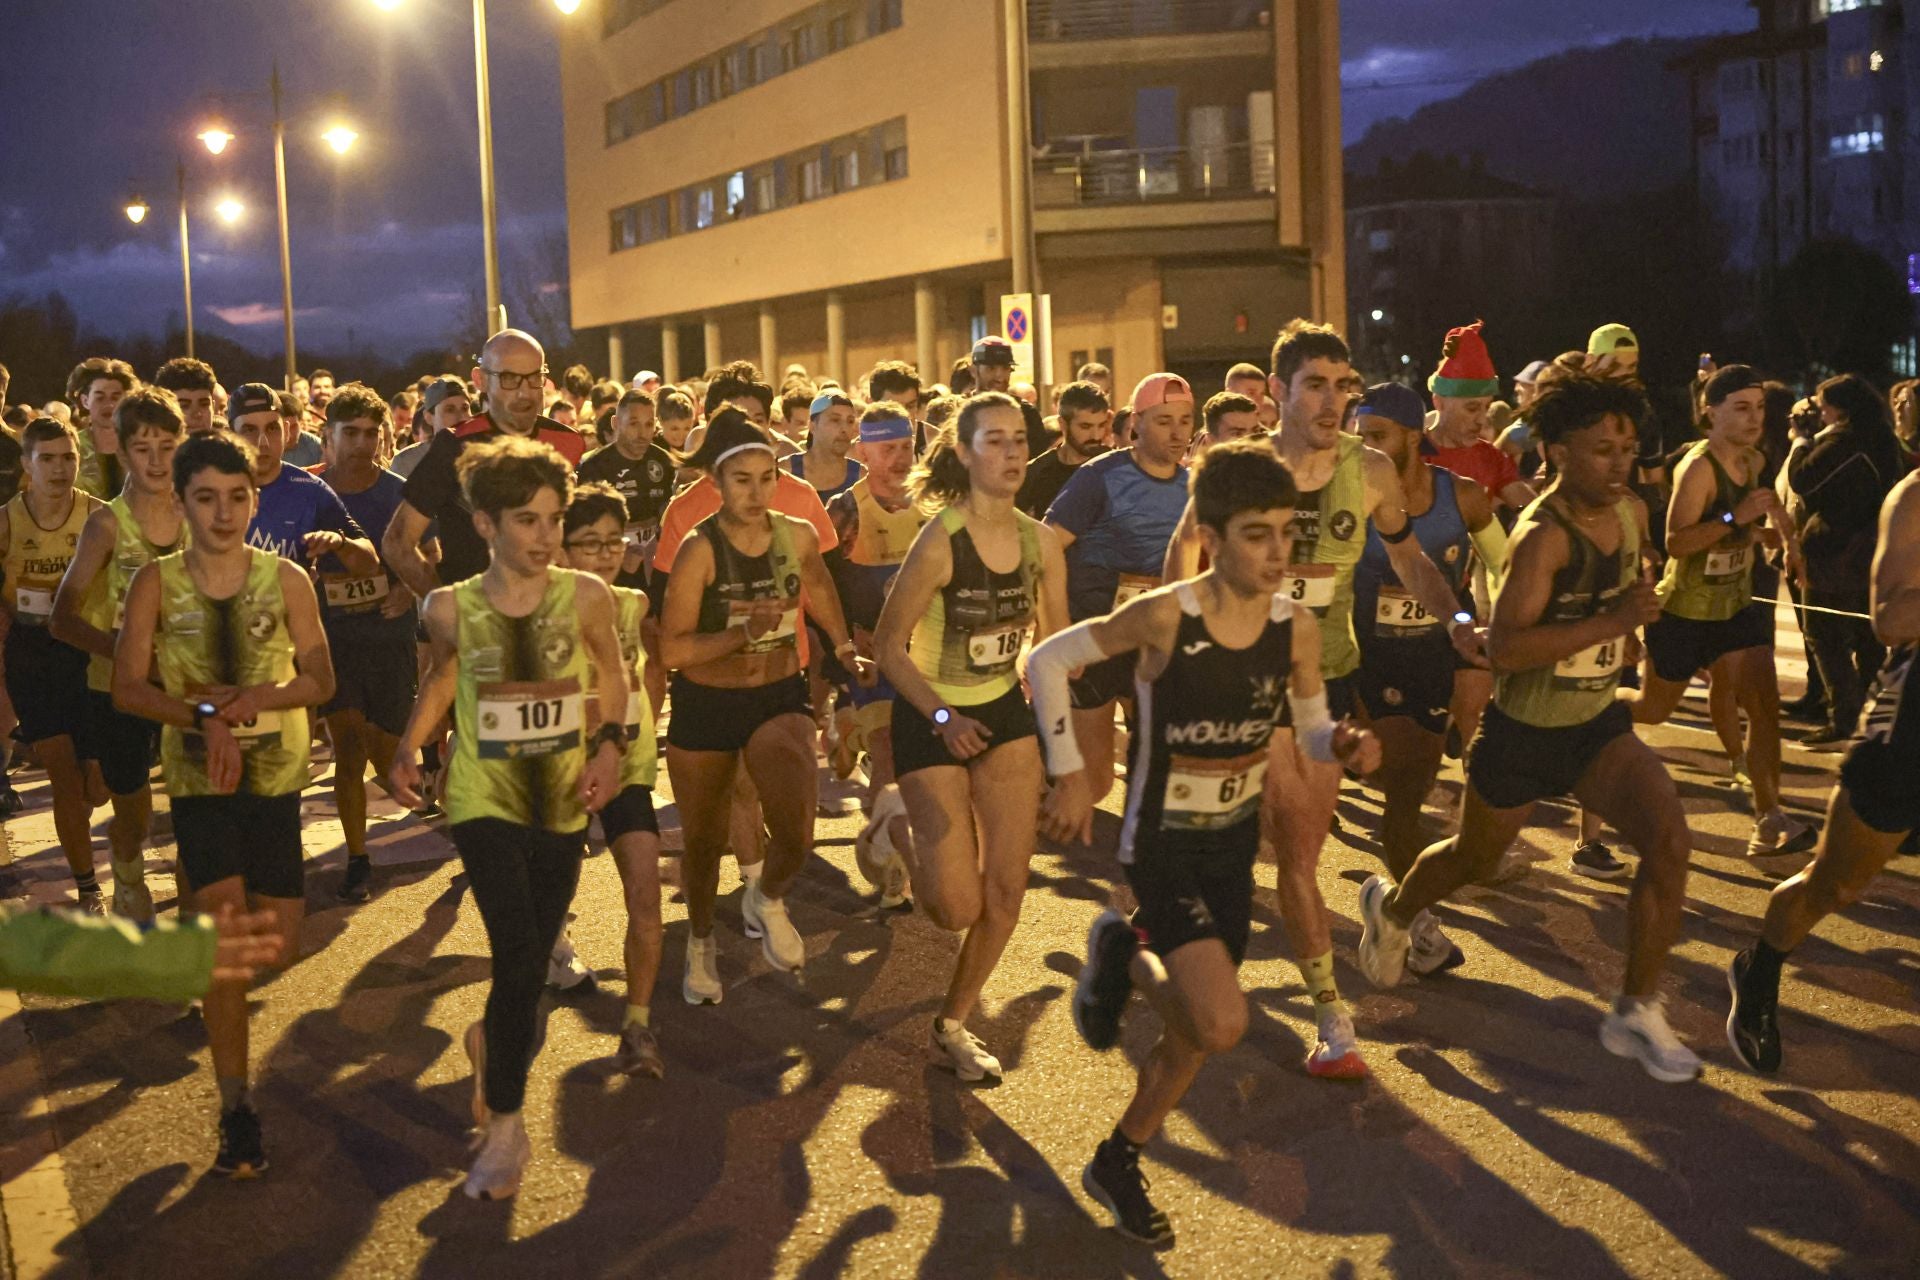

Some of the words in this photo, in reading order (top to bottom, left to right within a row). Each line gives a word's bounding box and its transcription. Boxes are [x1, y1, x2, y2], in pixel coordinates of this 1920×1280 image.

[345, 580, 376, 599] 213
[1291, 579, 1306, 600] 3
[1401, 601, 1432, 620] 28
[516, 699, 563, 731] 107
